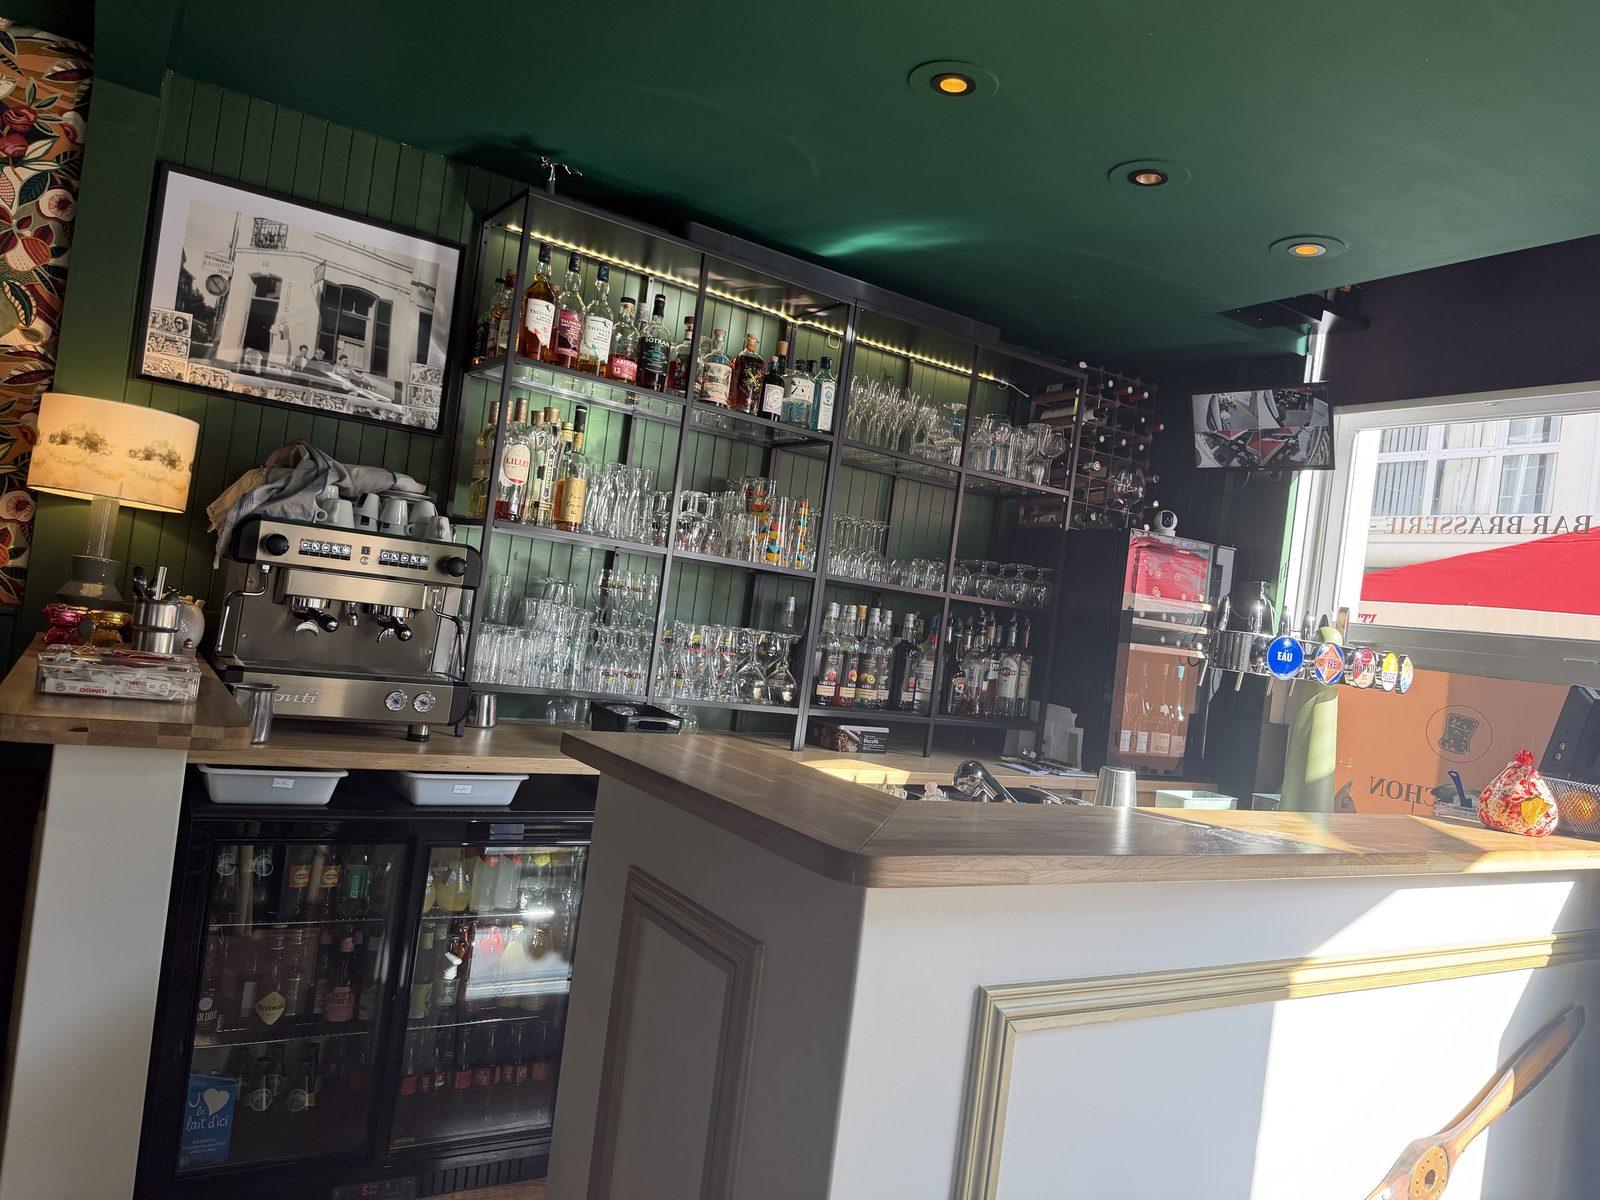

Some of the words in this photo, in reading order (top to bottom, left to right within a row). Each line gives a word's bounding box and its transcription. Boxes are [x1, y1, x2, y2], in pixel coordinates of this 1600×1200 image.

[1277, 651, 1293, 662] EAU
[186, 1115, 206, 1132] lait
[208, 1115, 228, 1129] d'ici
